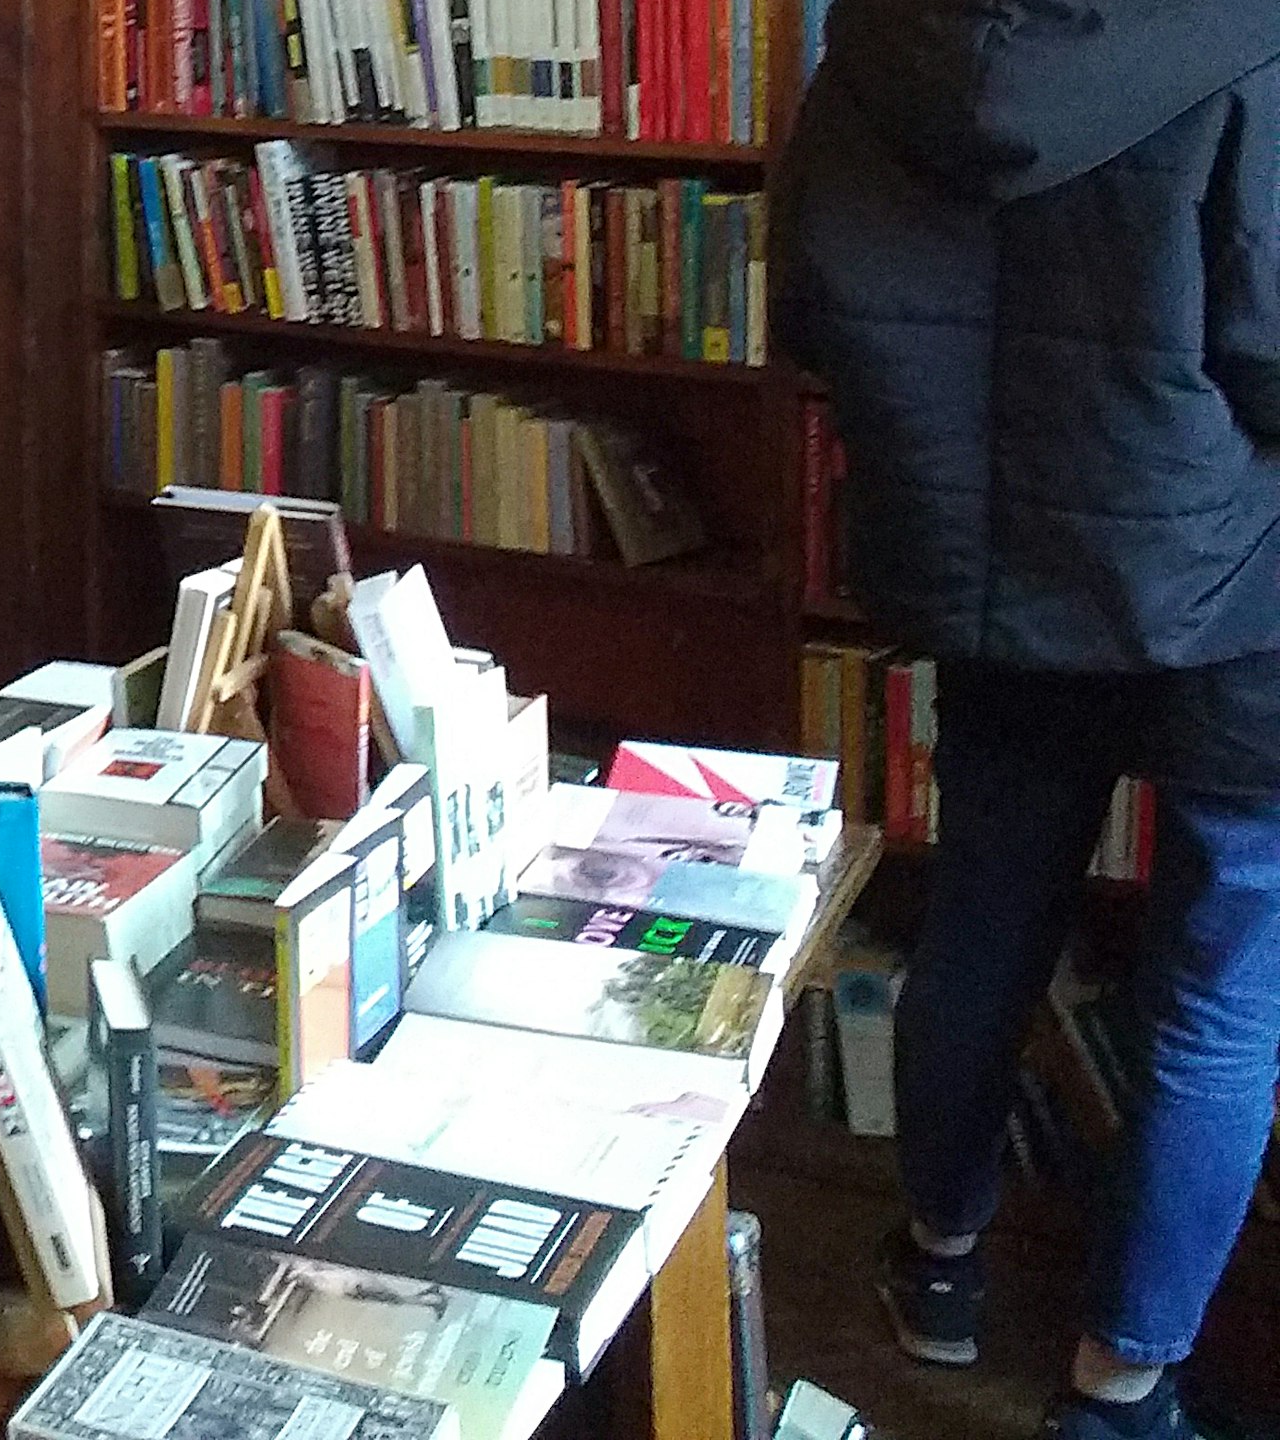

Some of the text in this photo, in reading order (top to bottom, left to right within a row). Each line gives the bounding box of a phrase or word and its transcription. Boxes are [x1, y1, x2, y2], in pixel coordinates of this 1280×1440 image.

[220, 1143, 354, 1237] THE AGE
[355, 1192, 437, 1232] OF
[455, 1198, 564, 1279] JIHAD
